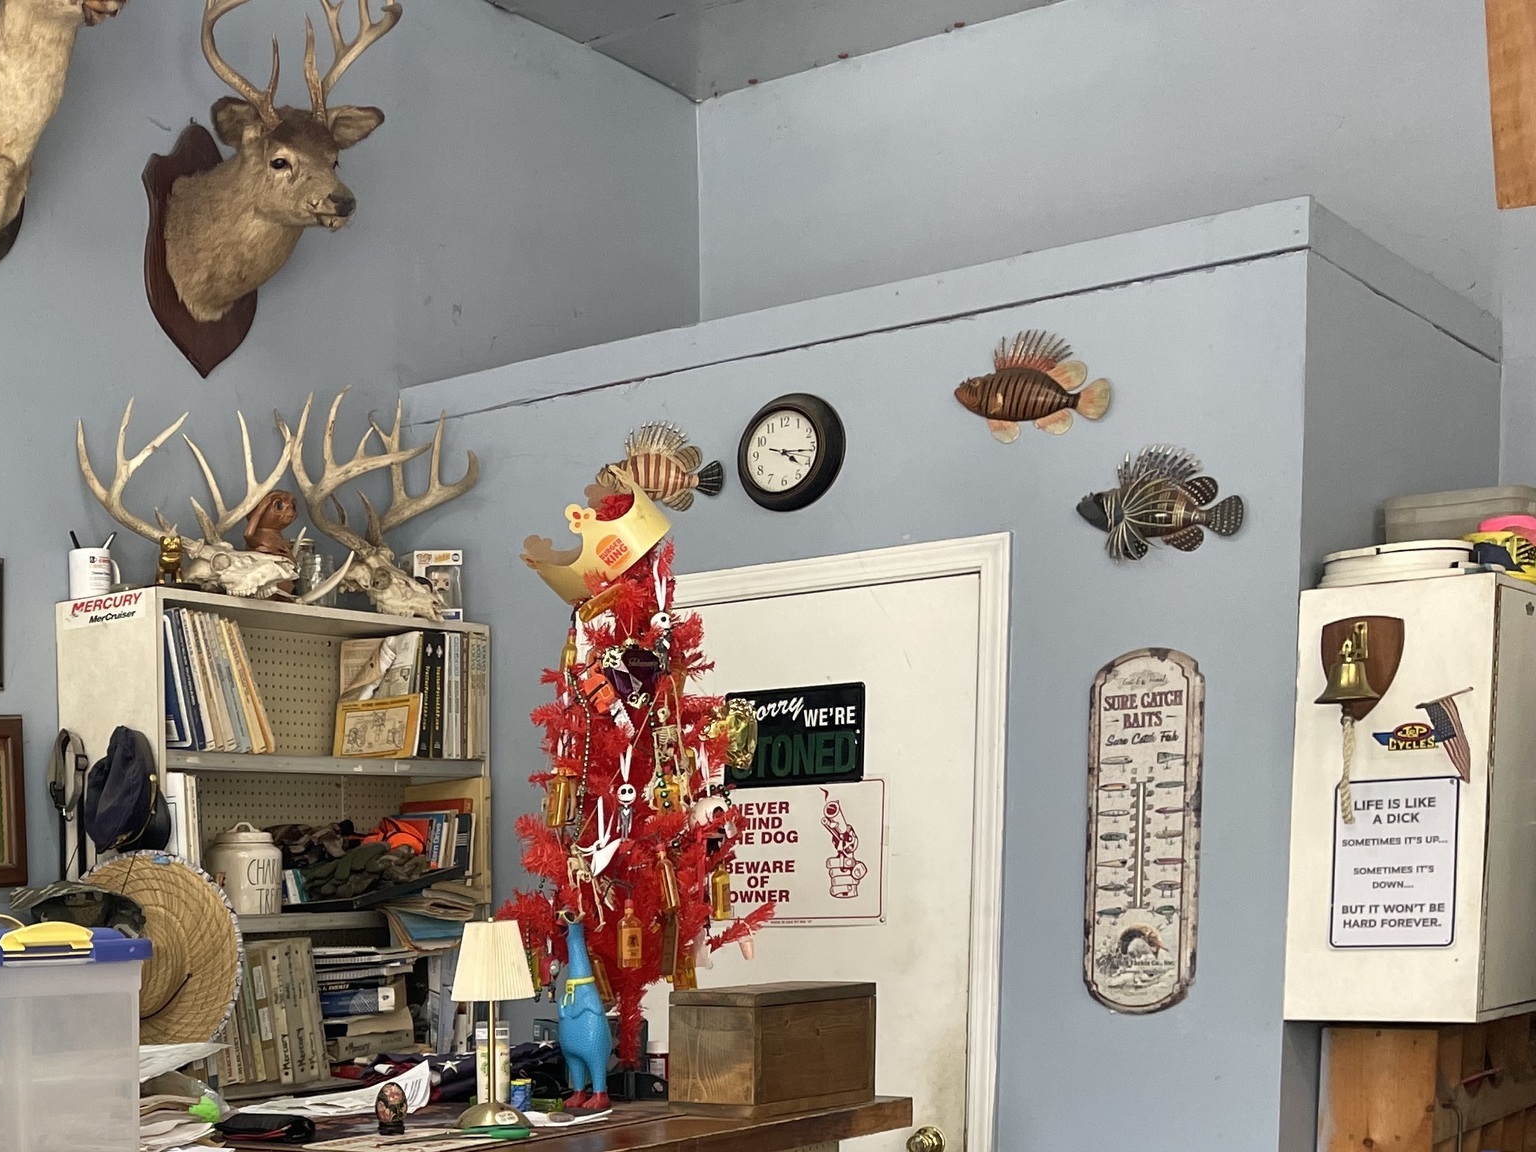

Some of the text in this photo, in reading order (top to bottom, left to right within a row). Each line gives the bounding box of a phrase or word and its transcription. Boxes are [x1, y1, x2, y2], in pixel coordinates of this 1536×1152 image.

[780, 416, 789, 427] 12
[757, 436, 766, 447] 10
[757, 465, 764, 475] 8
[599, 538, 622, 560] BURGER
[604, 544, 628, 566] KING
[71, 592, 142, 616] MERCURY
[89, 610, 136, 623] MerCruiser
[1104, 690, 1183, 711] SURE CATCH
[748, 696, 856, 727] orry WE'RE
[1123, 711, 1162, 730] BAITS
[1389, 735, 1435, 750] CYCLES
[731, 730, 859, 779] TONED
[1354, 797, 1436, 811] LIFE IS LIKE
[746, 817, 783, 830] IND
[1373, 813, 1419, 824] A DICK
[761, 830, 798, 843] DOG
[1342, 837, 1401, 846] SOMETIMES
[726, 860, 795, 874] BEWARE
[1354, 865, 1434, 875] SOMETIMES IT'S
[747, 876, 769, 888] OF
[730, 890, 789, 903] OWNER
[1342, 903, 1445, 914] BUT IT WON'T BE
[1343, 918, 1441, 928] HARD FOREVER.
[281, 1034, 290, 1070] Mercury
